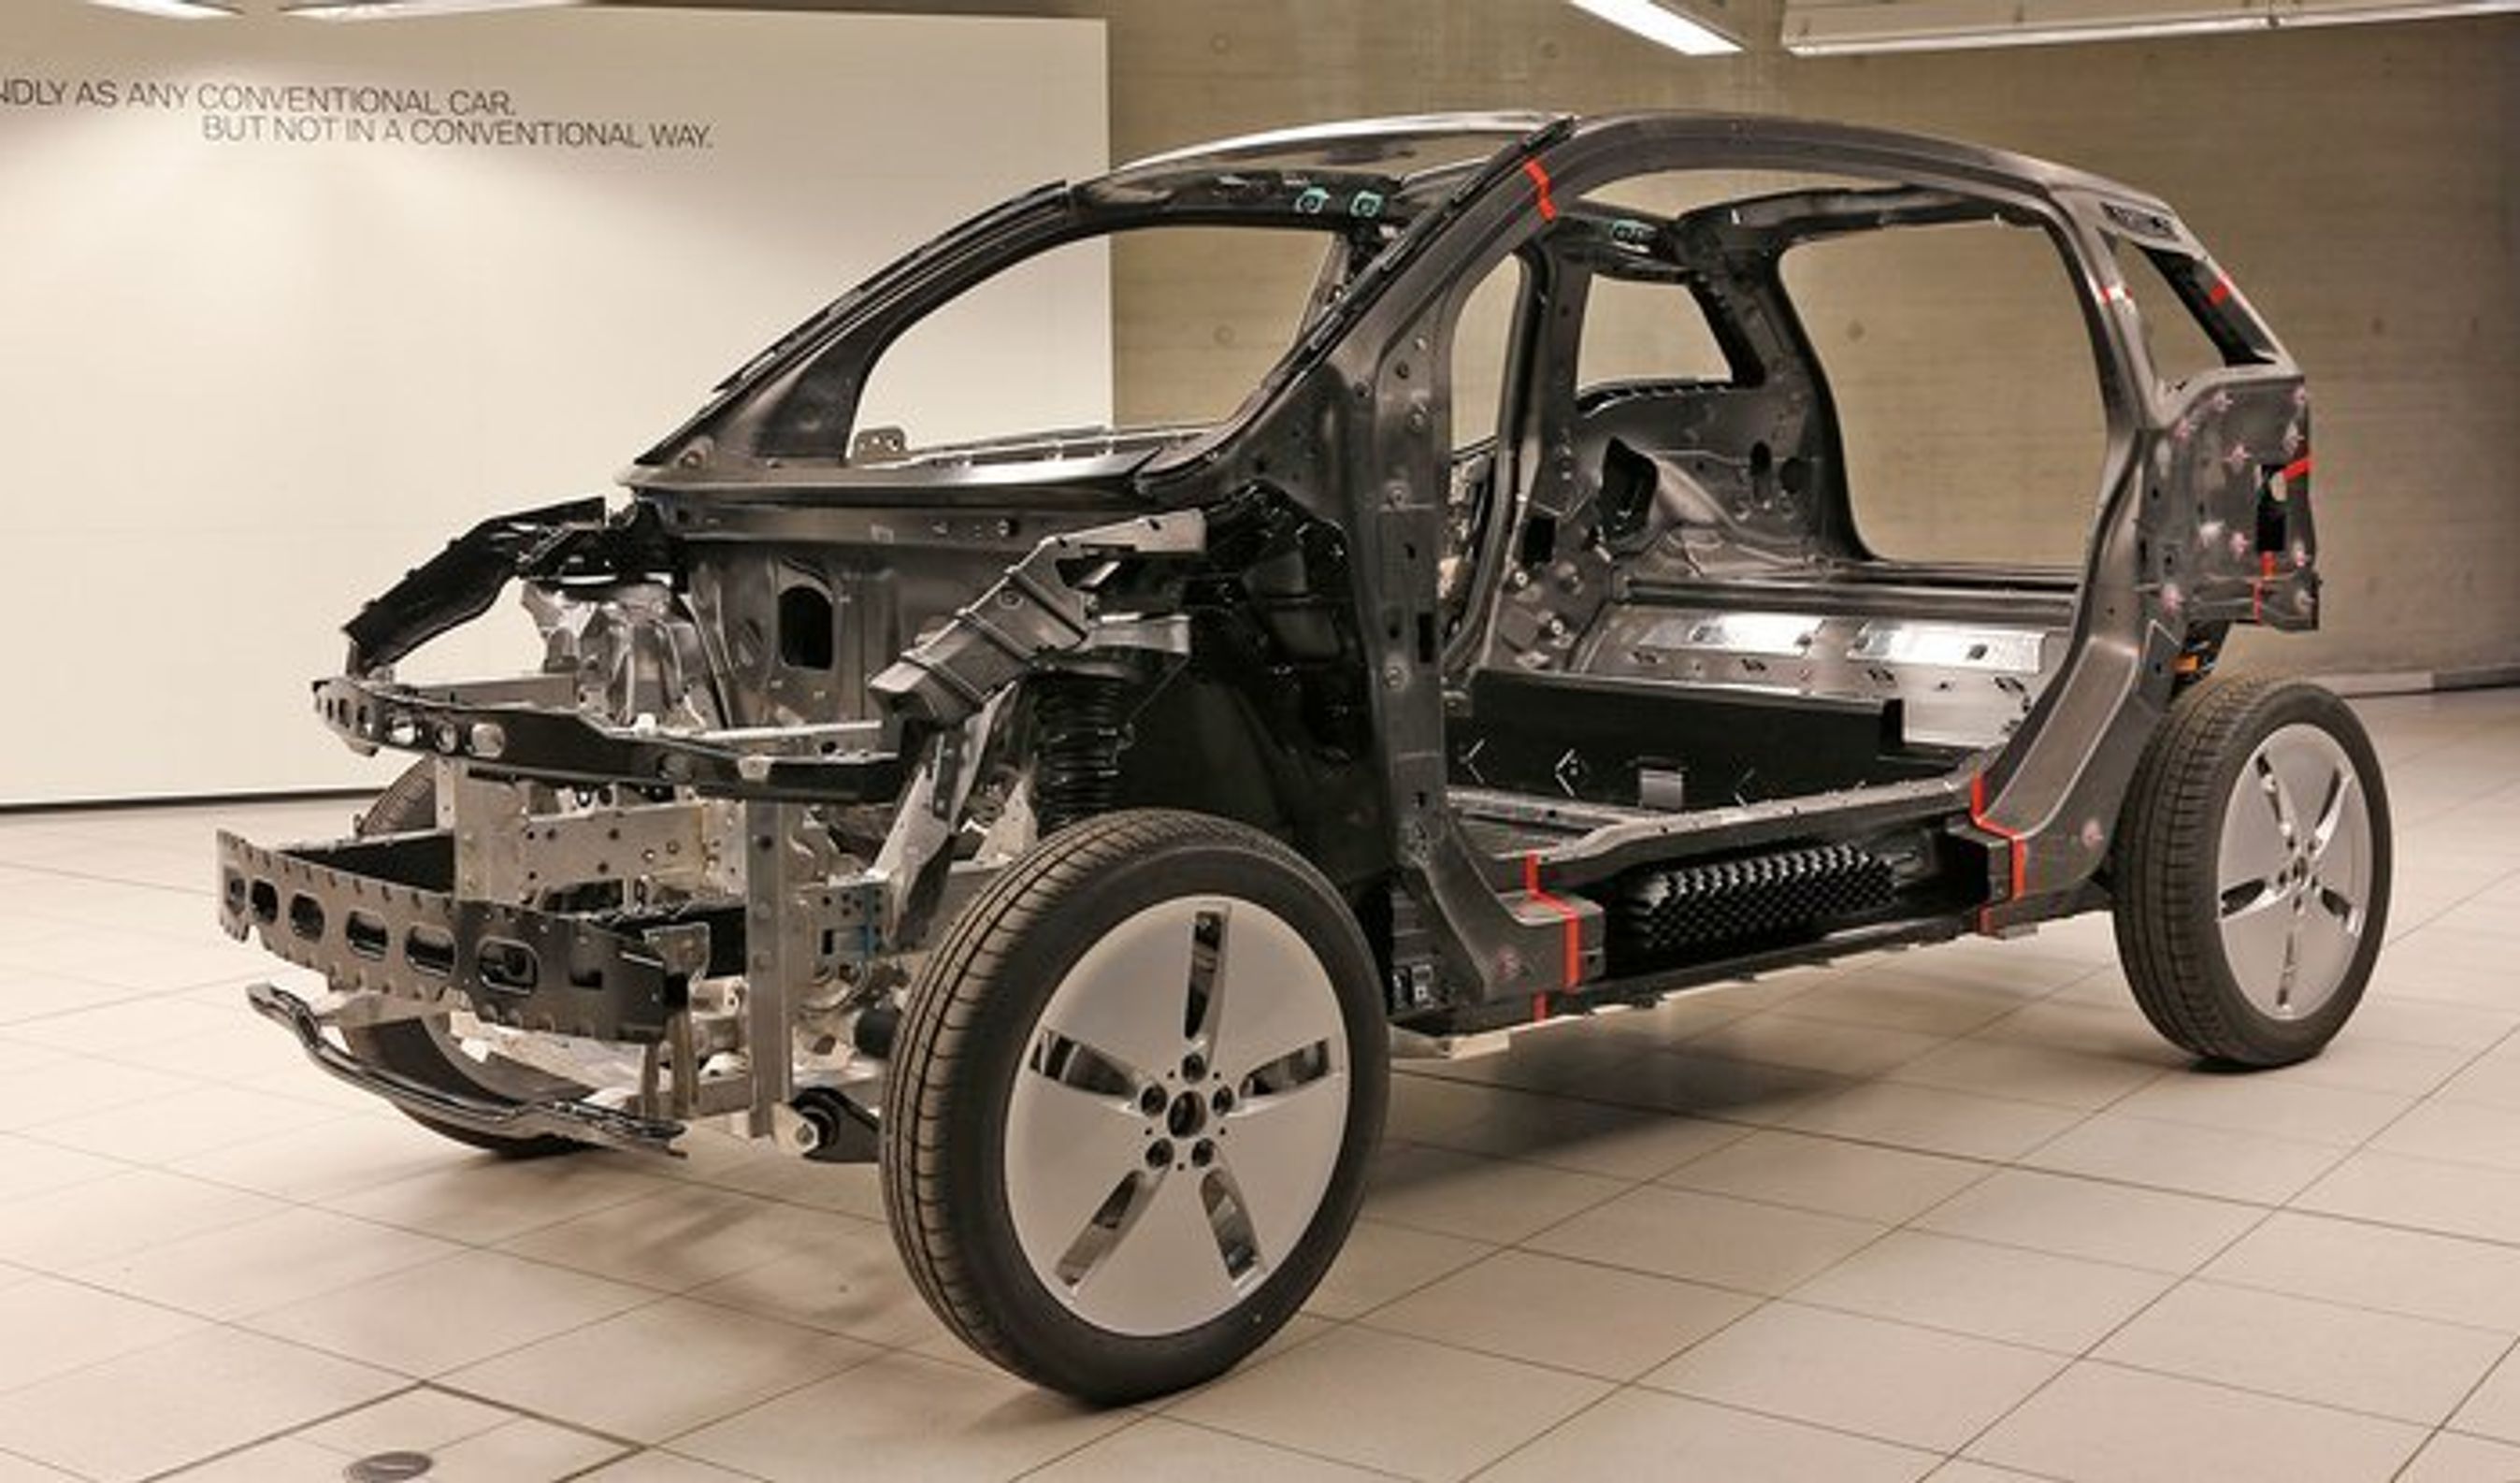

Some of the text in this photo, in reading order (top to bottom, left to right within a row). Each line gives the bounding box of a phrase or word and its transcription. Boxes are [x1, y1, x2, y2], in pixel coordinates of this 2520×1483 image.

[76, 79, 118, 108] AS
[126, 81, 190, 108] ANY
[197, 83, 439, 115] CONVENTIONAL
[449, 89, 516, 116] CAR.
[203, 114, 713, 149] BUT NOT IN A CONVENTIONAL WAY.
